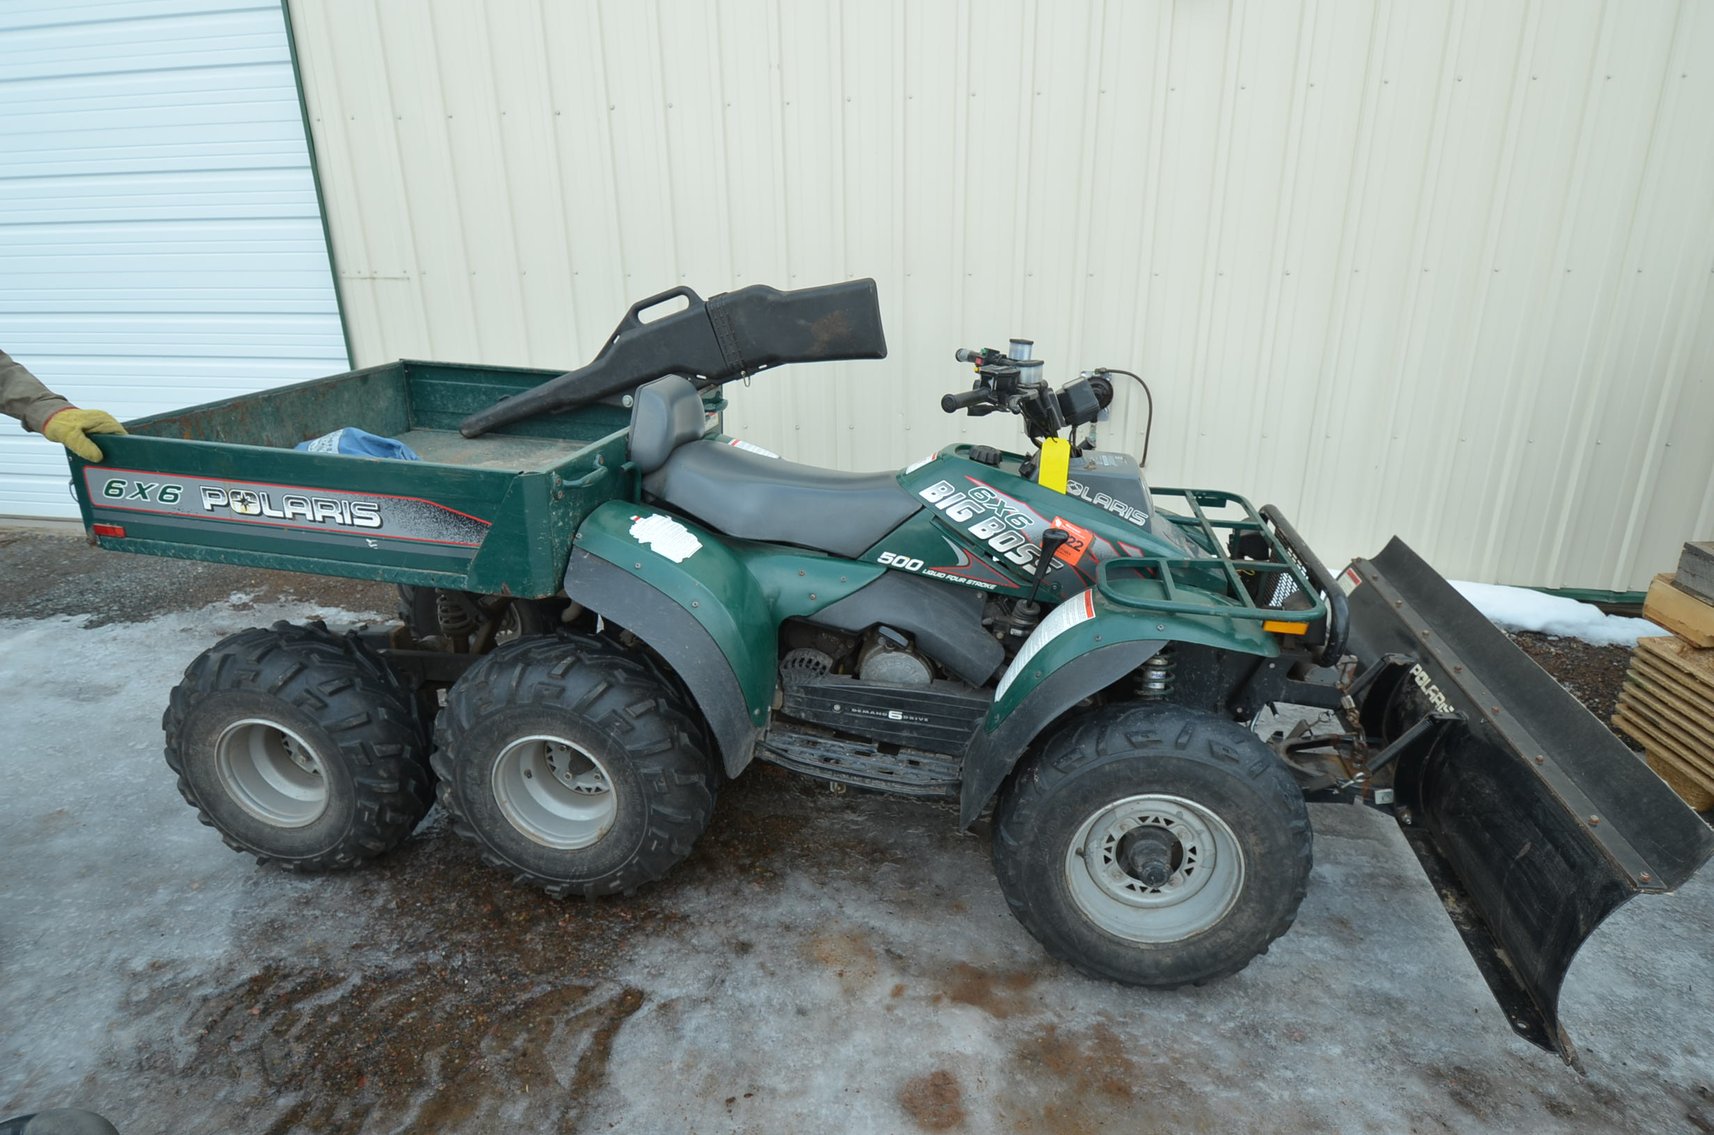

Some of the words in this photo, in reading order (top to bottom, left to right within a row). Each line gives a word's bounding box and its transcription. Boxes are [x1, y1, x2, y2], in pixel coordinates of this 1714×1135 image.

[103, 478, 183, 504] 6X6
[199, 485, 383, 528] POLARIS
[918, 479, 986, 523] BIG
[968, 486, 1034, 530] 6X6
[1067, 480, 1149, 527] OLARIS
[877, 551, 924, 572] 500
[922, 569, 945, 579] LIQUID
[945, 574, 967, 583] FOUR
[966, 579, 997, 590] STROKE
